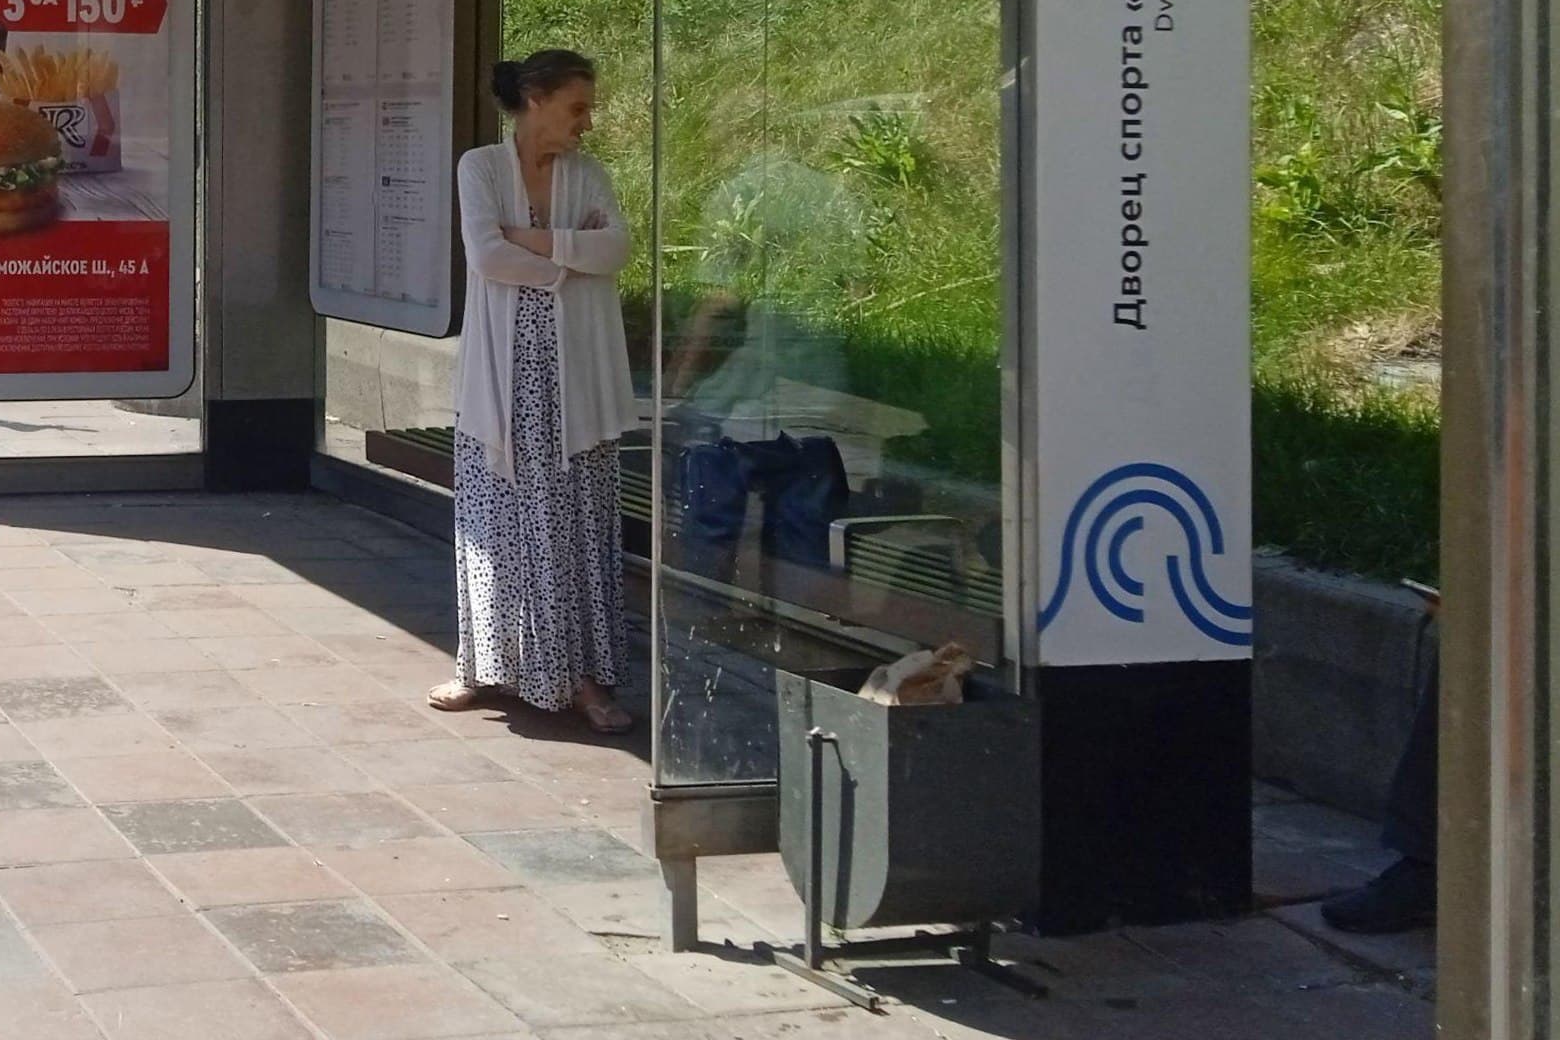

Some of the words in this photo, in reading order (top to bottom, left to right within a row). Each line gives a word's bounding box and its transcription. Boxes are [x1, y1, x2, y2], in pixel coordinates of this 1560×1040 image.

[1120, 25, 1150, 161] спорта
[91, 261, 116, 279] Ш.,
[118, 260, 136, 275] 45
[139, 259, 149, 275] А
[1113, 173, 1149, 331] Дворец
